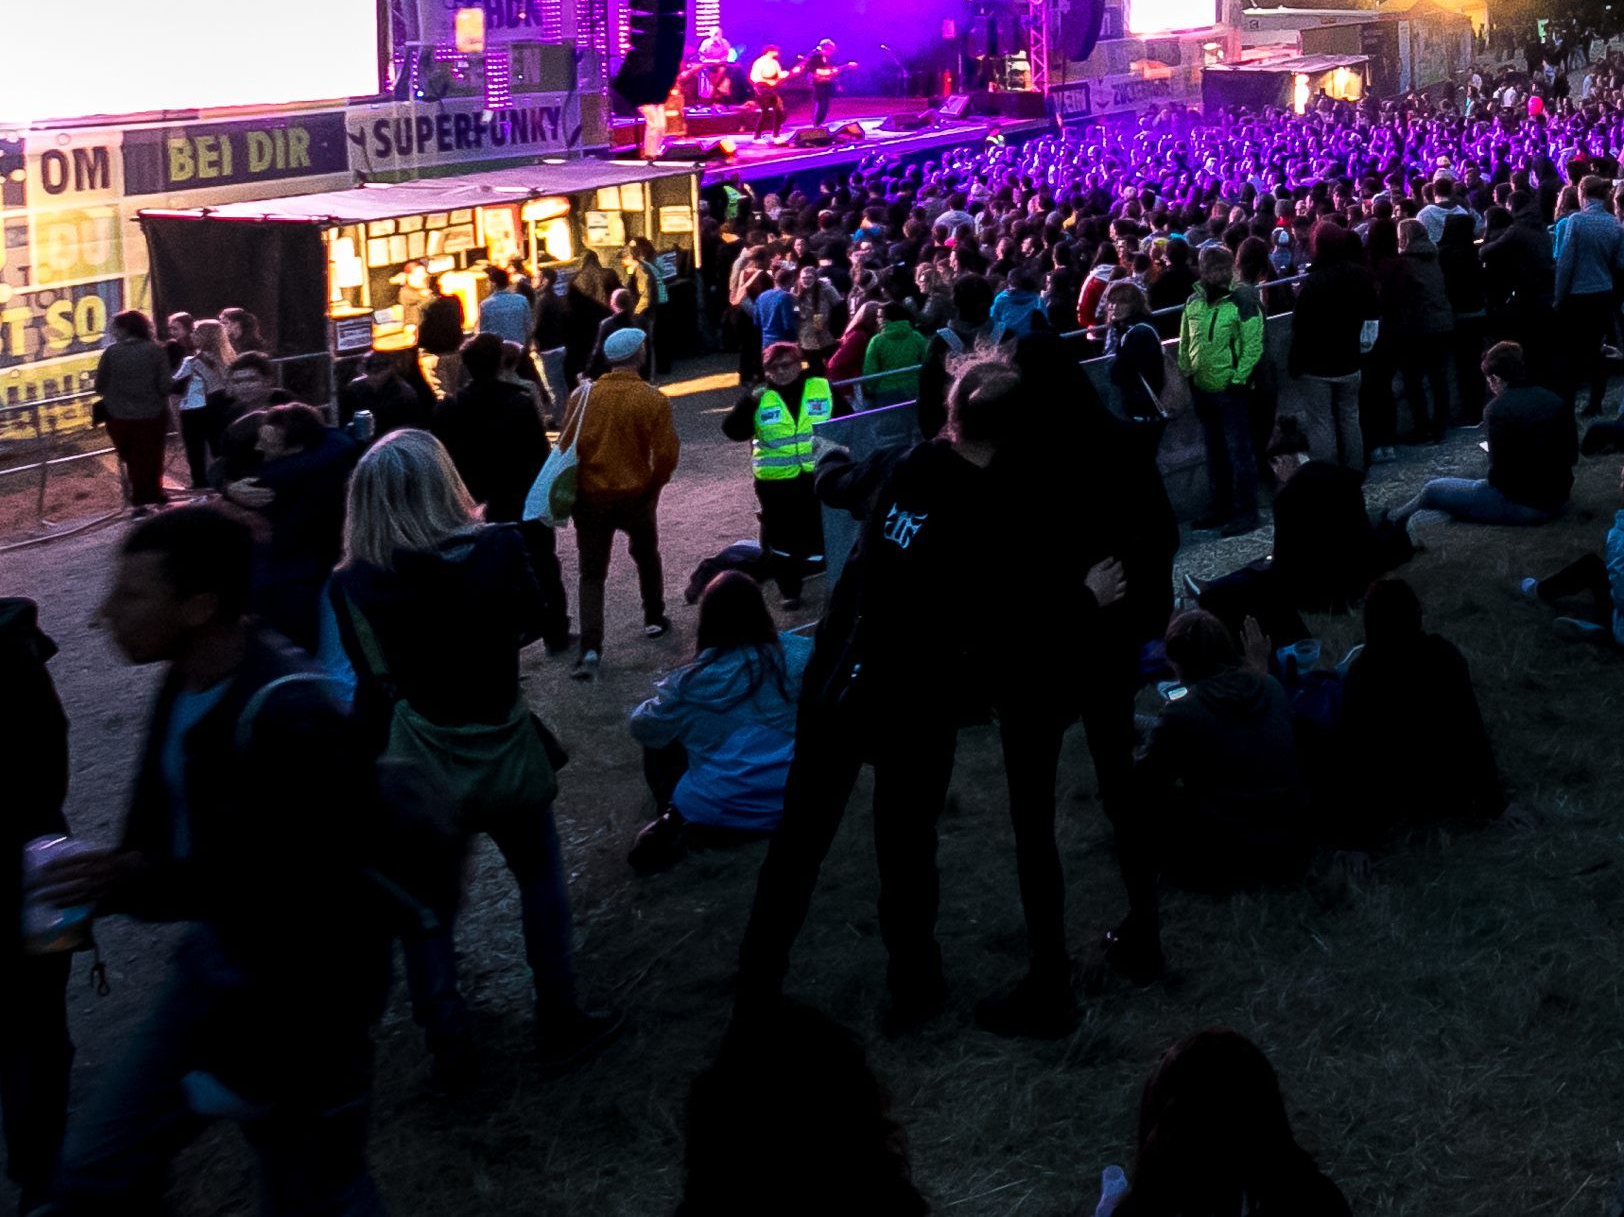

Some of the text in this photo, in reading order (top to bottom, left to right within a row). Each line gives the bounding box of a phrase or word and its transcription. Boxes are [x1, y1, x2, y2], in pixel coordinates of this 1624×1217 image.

[168, 126, 312, 182] BEI DIR
[373, 105, 562, 158] SUPERFUNKY
[41, 145, 110, 195] OM
[46, 294, 107, 350] SO
